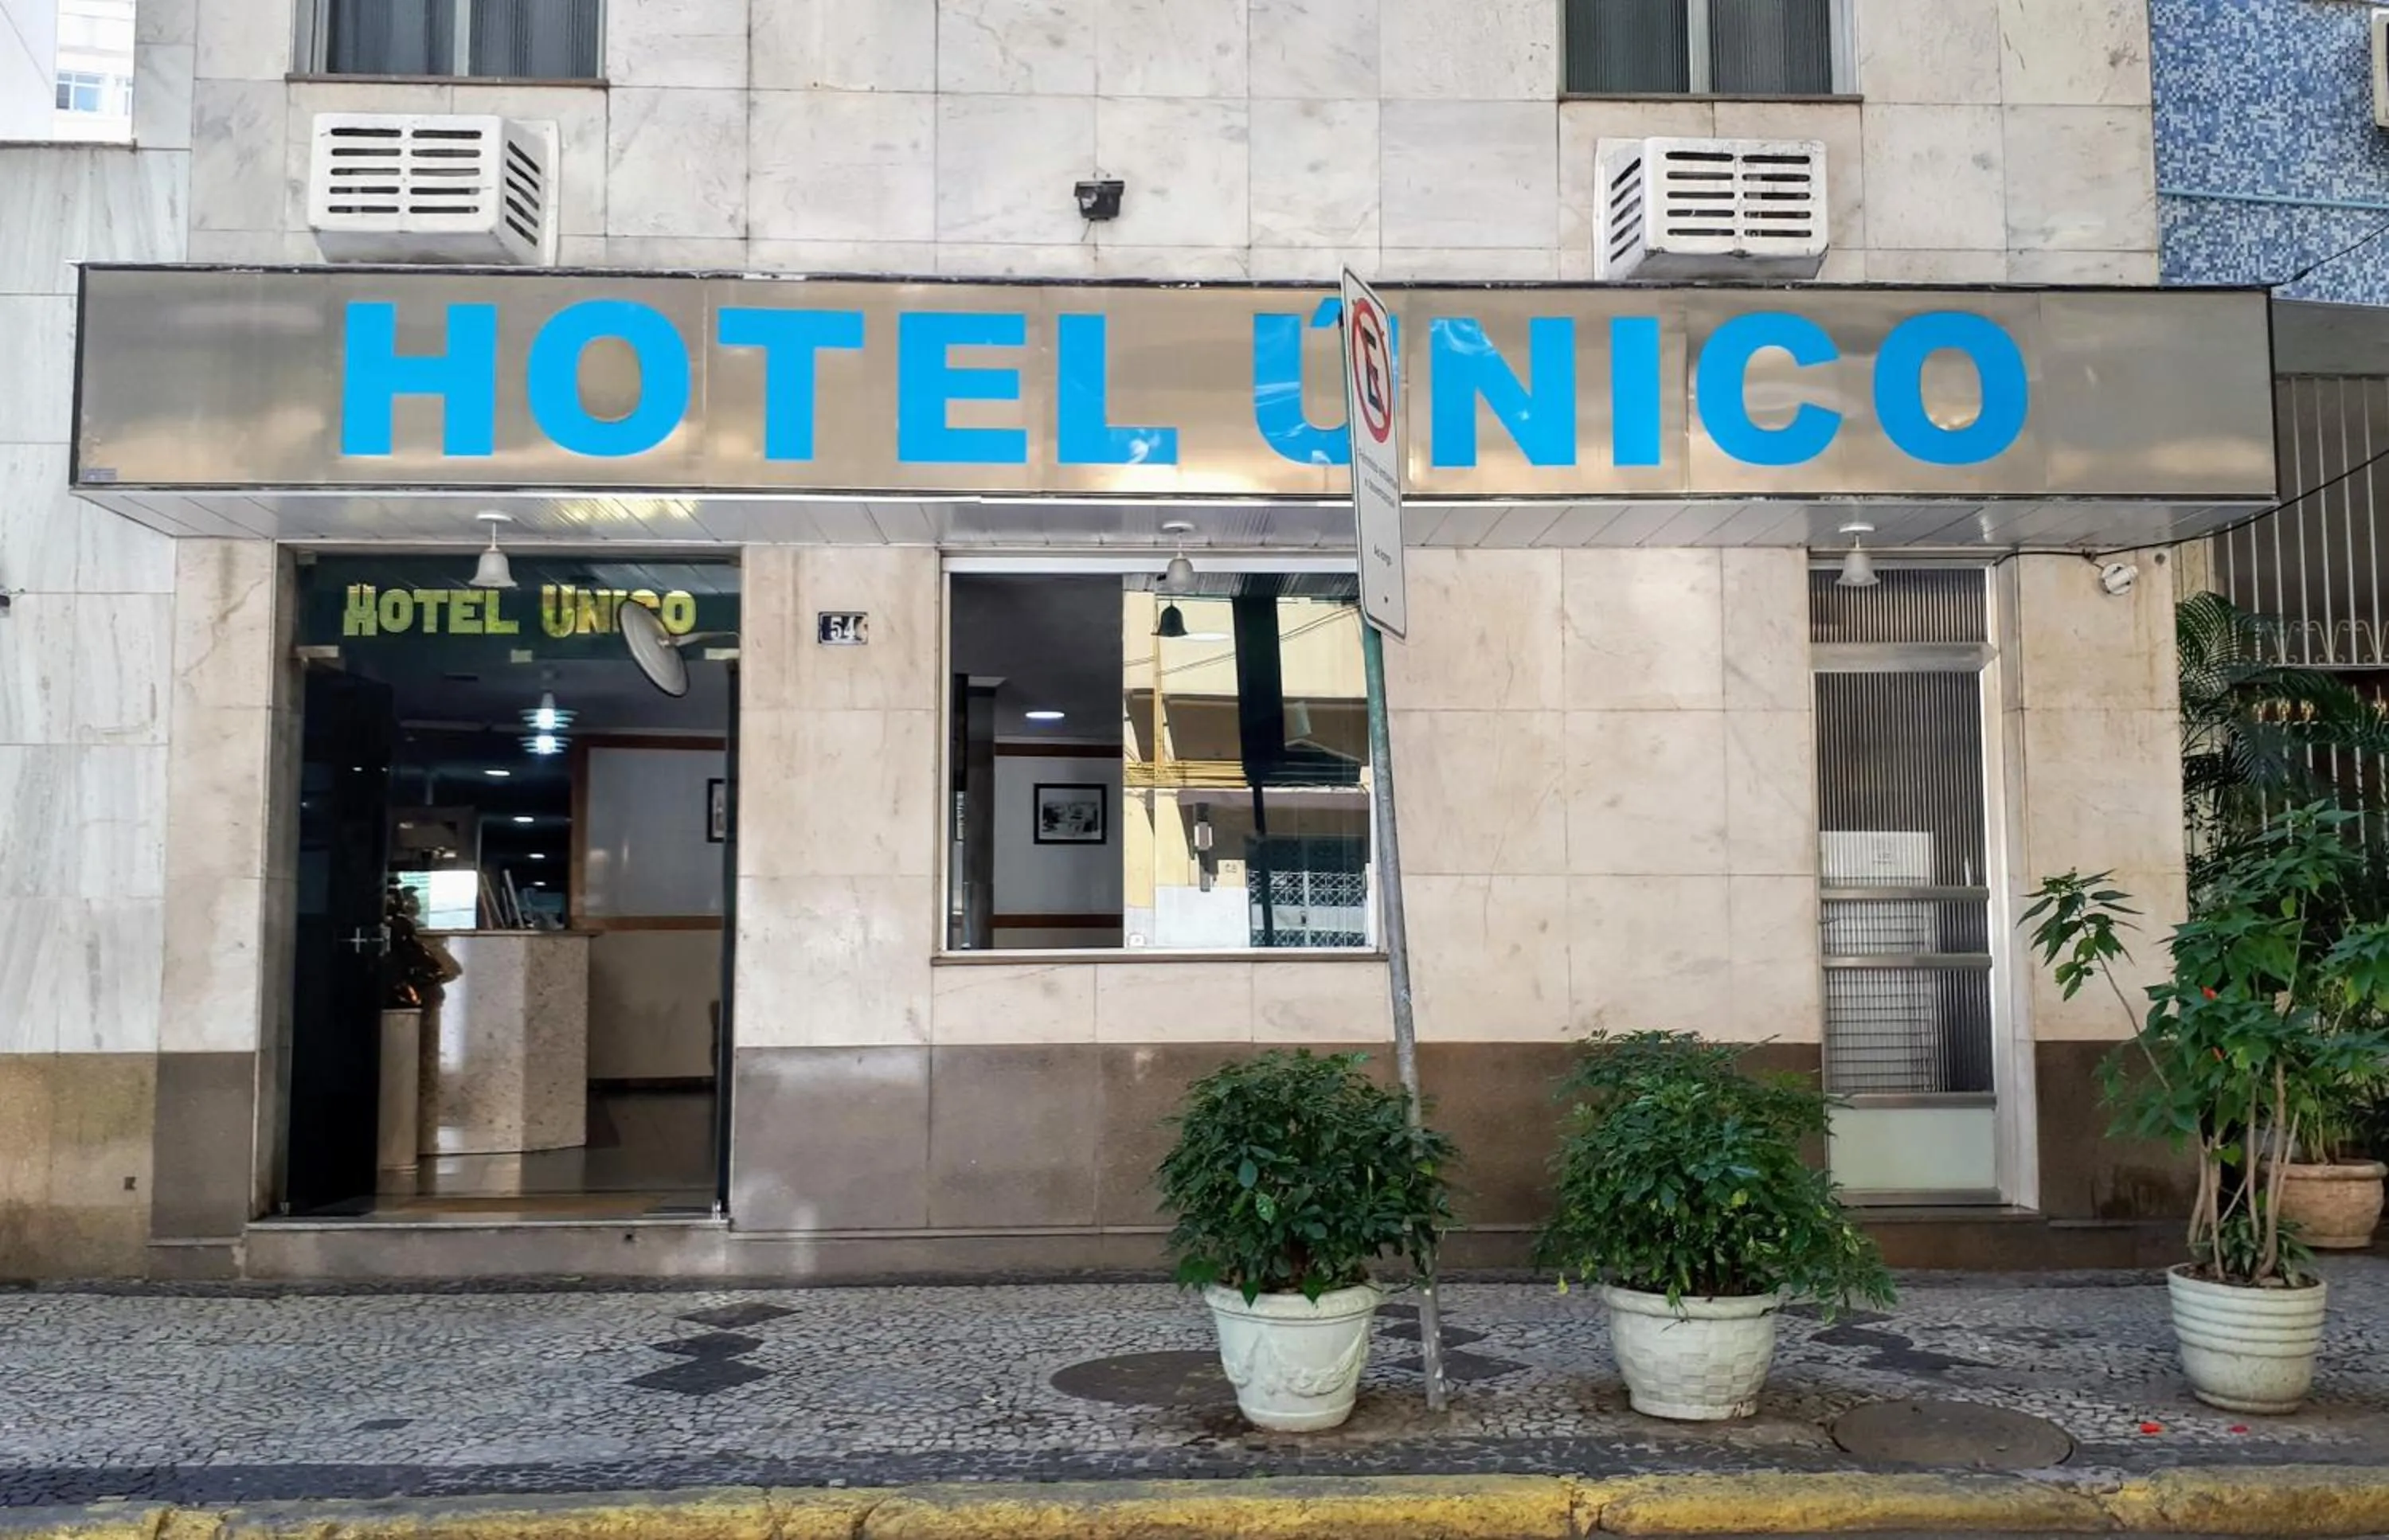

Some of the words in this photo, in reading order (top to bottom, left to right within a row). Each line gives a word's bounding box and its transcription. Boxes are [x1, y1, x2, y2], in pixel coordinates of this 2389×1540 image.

[341, 300, 1177, 464] HOTEL
[343, 584, 519, 636] HOTEL
[831, 616, 855, 641] 54
